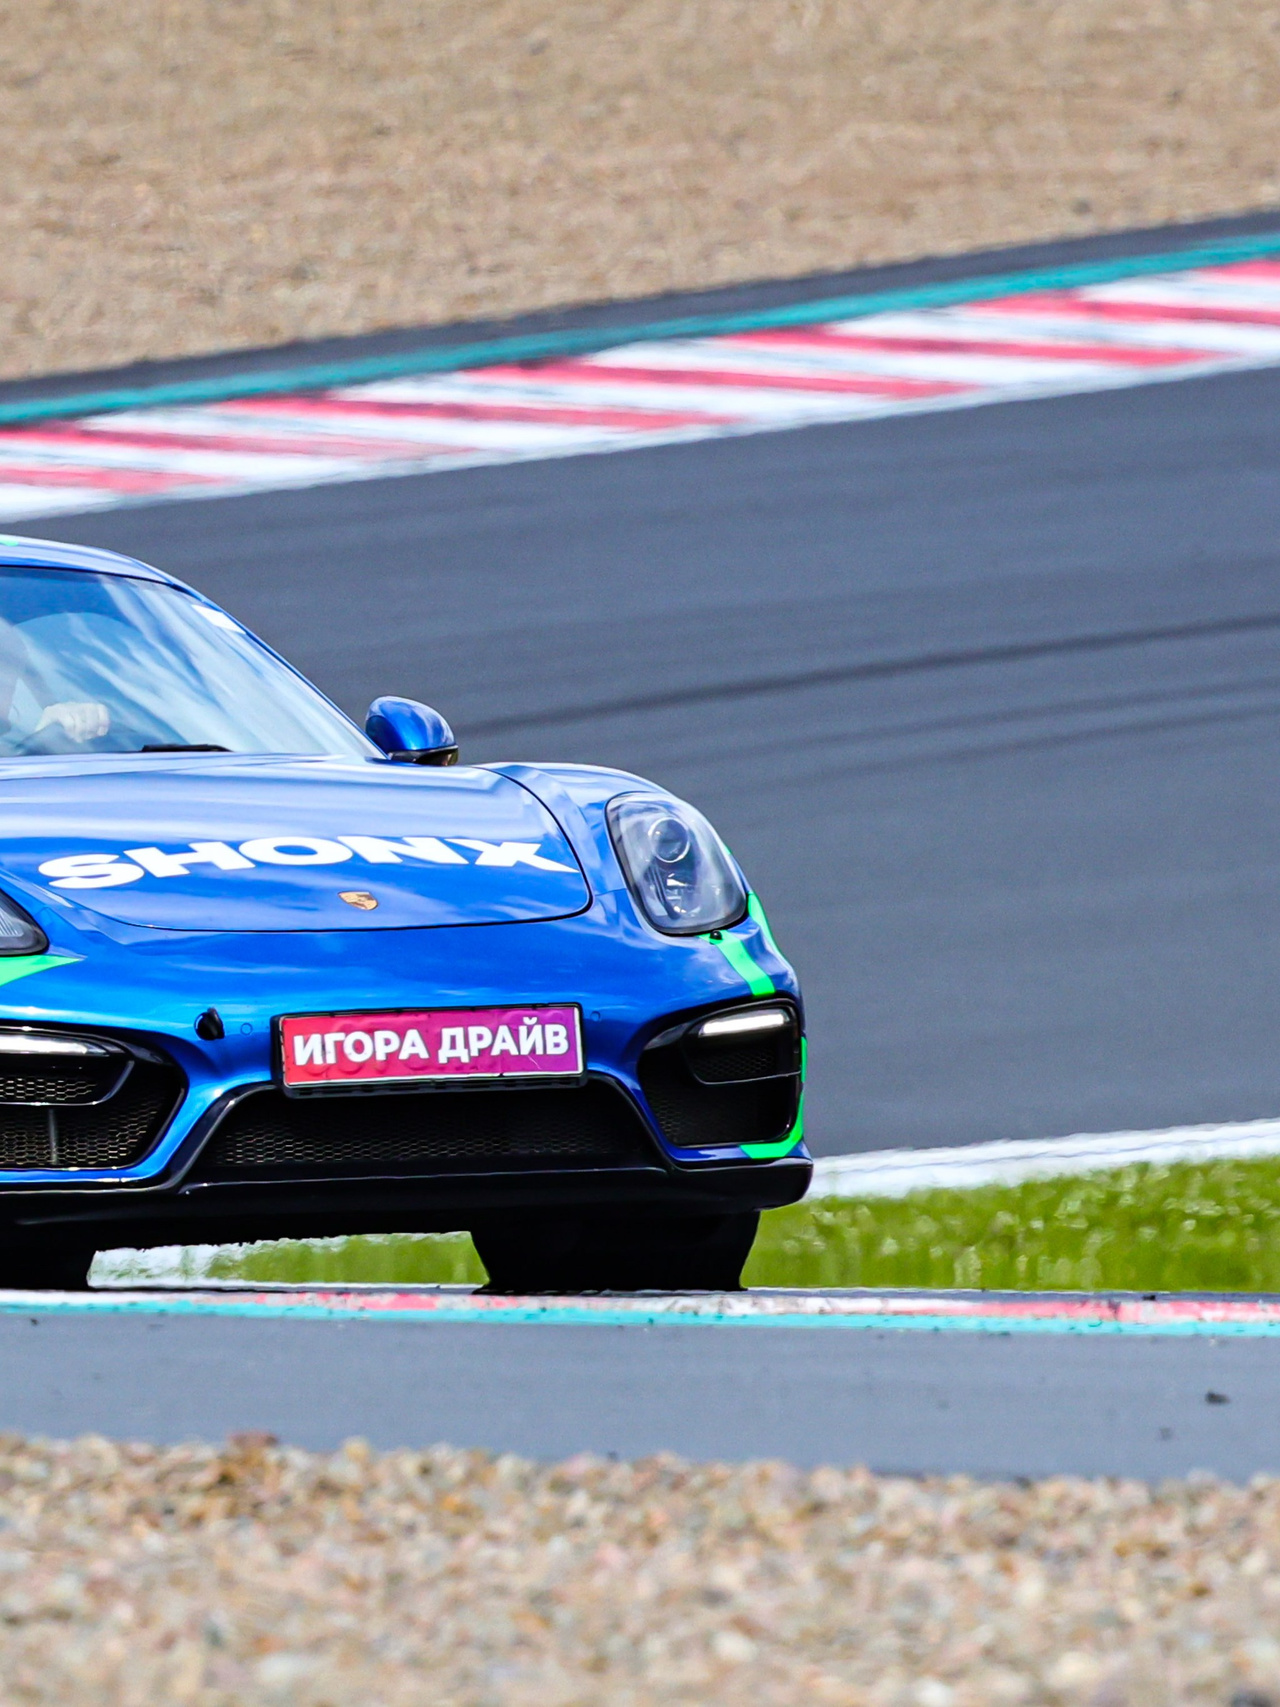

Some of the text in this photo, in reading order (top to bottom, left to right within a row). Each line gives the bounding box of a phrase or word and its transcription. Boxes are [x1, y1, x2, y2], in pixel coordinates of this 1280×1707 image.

[39, 836, 580, 889] SHONX
[293, 1016, 569, 1066] ИГОРА ДРАЙВ
